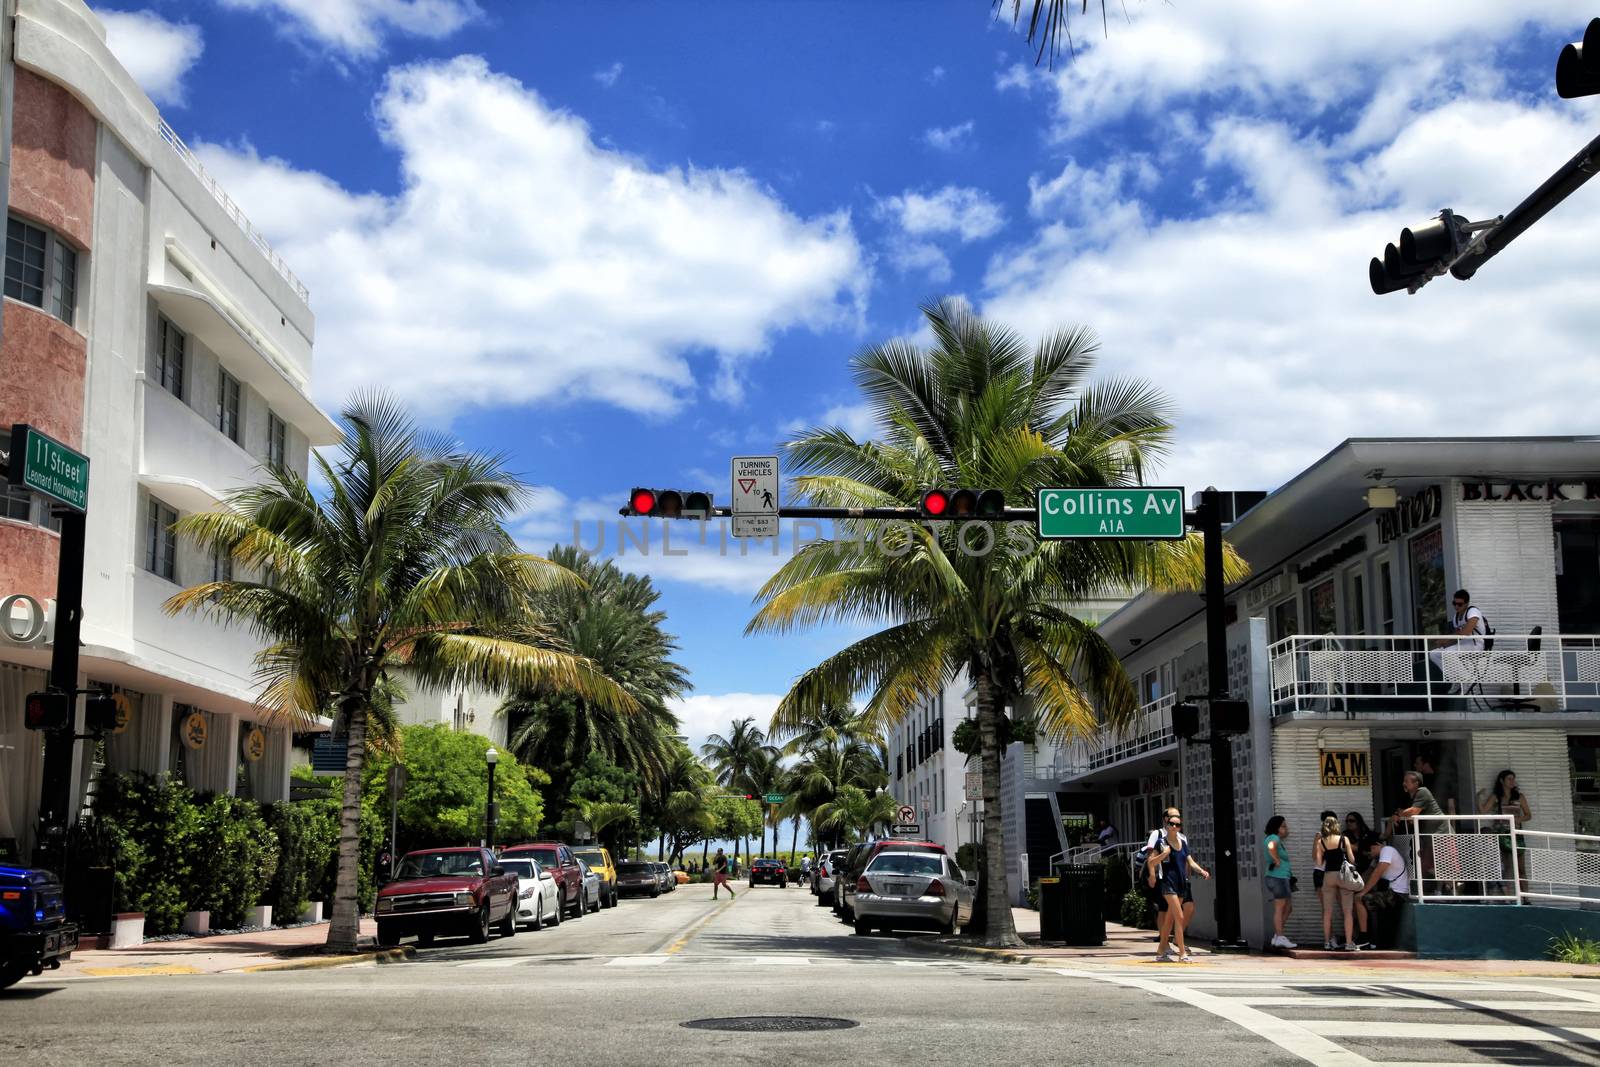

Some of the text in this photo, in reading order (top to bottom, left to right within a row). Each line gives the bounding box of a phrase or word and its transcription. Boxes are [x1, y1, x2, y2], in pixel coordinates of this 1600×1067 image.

[37, 439, 80, 483] 11 Street
[740, 461, 771, 469] TURNING
[26, 464, 52, 489] Leonard
[53, 477, 78, 501] Horowitz
[1462, 481, 1569, 501] BLACK
[1045, 493, 1177, 515] Collins Av
[1376, 485, 1442, 544] TATTOO
[1099, 519, 1125, 532] A1A
[1323, 752, 1367, 776] ATM
[1323, 777, 1368, 785] INSIDE
